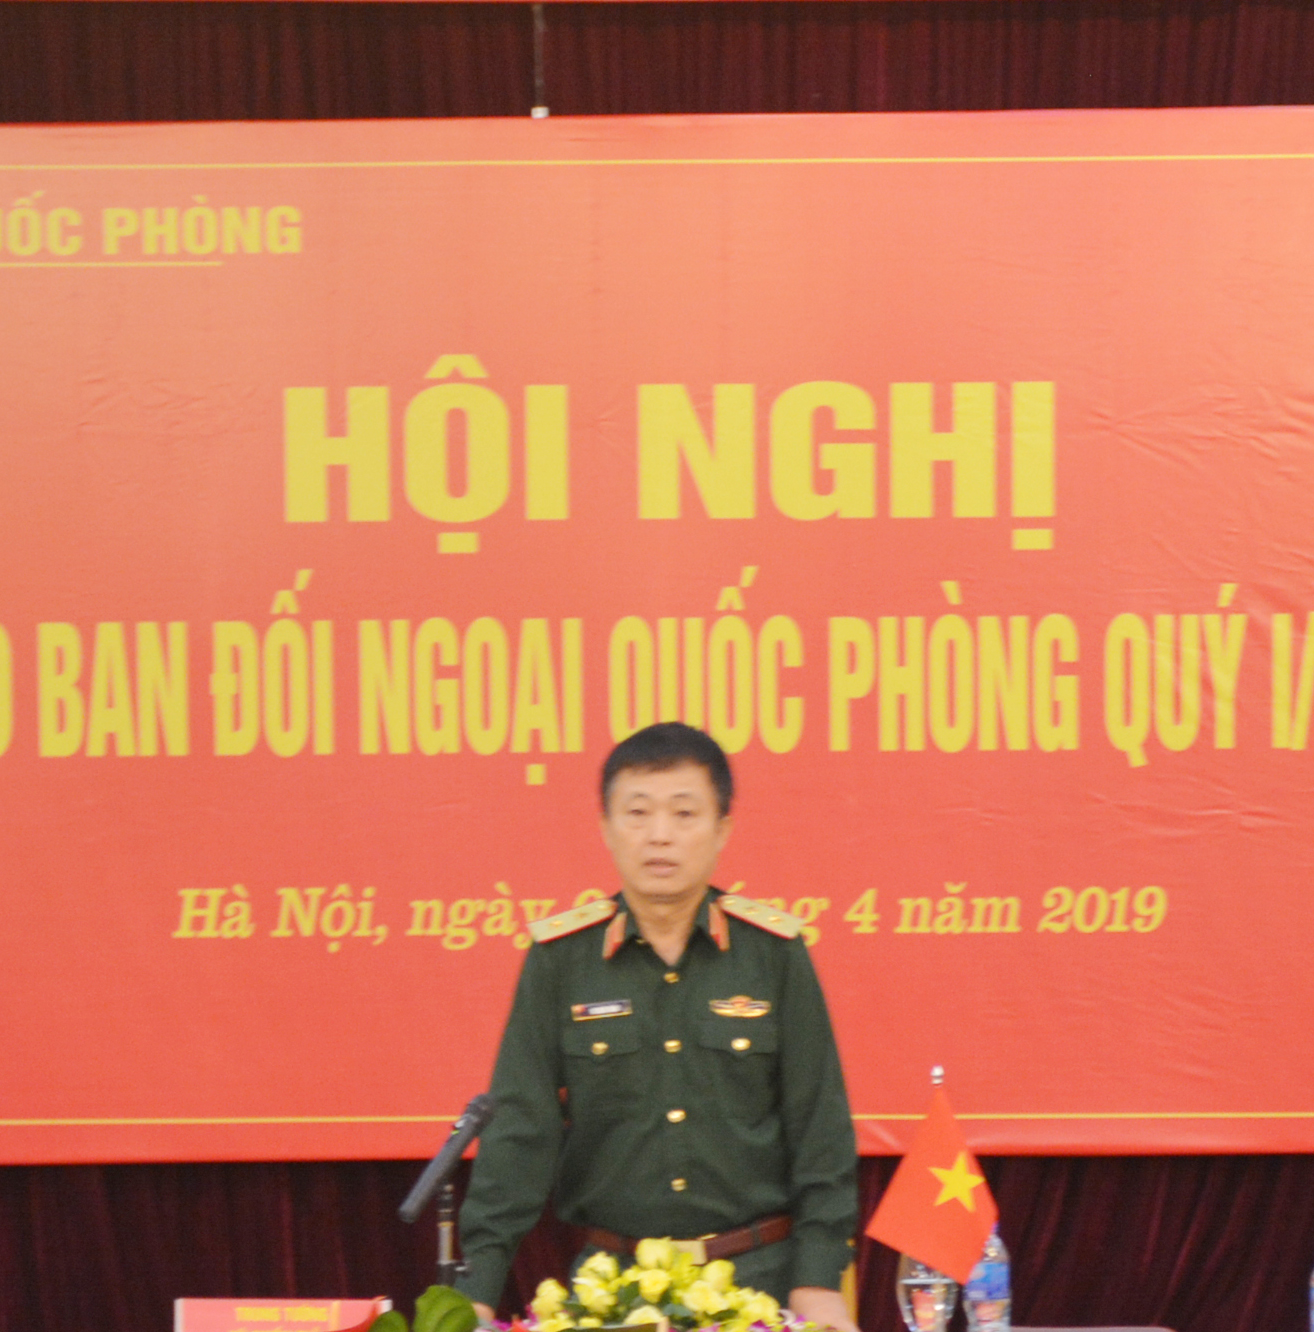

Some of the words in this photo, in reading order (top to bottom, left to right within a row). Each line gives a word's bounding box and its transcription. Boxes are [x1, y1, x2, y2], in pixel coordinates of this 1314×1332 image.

[103, 195, 303, 256] PHÒNG
[284, 354, 570, 554] HỘI
[637, 380, 1056, 551] NGHỊ
[37, 621, 190, 758] BAN
[210, 569, 335, 758] ĐỐI
[358, 616, 585, 786] NGOẠI
[608, 565, 804, 754] QUỐC
[828, 580, 1080, 753] PHÒNG
[1104, 583, 1248, 767] QUÝ
[172, 884, 255, 939] Hà
[270, 883, 389, 953] Nội,
[405, 881, 556, 950] ngày
[844, 888, 881, 934] 4
[893, 882, 1022, 935] năm
[1037, 885, 1169, 934] 2019
